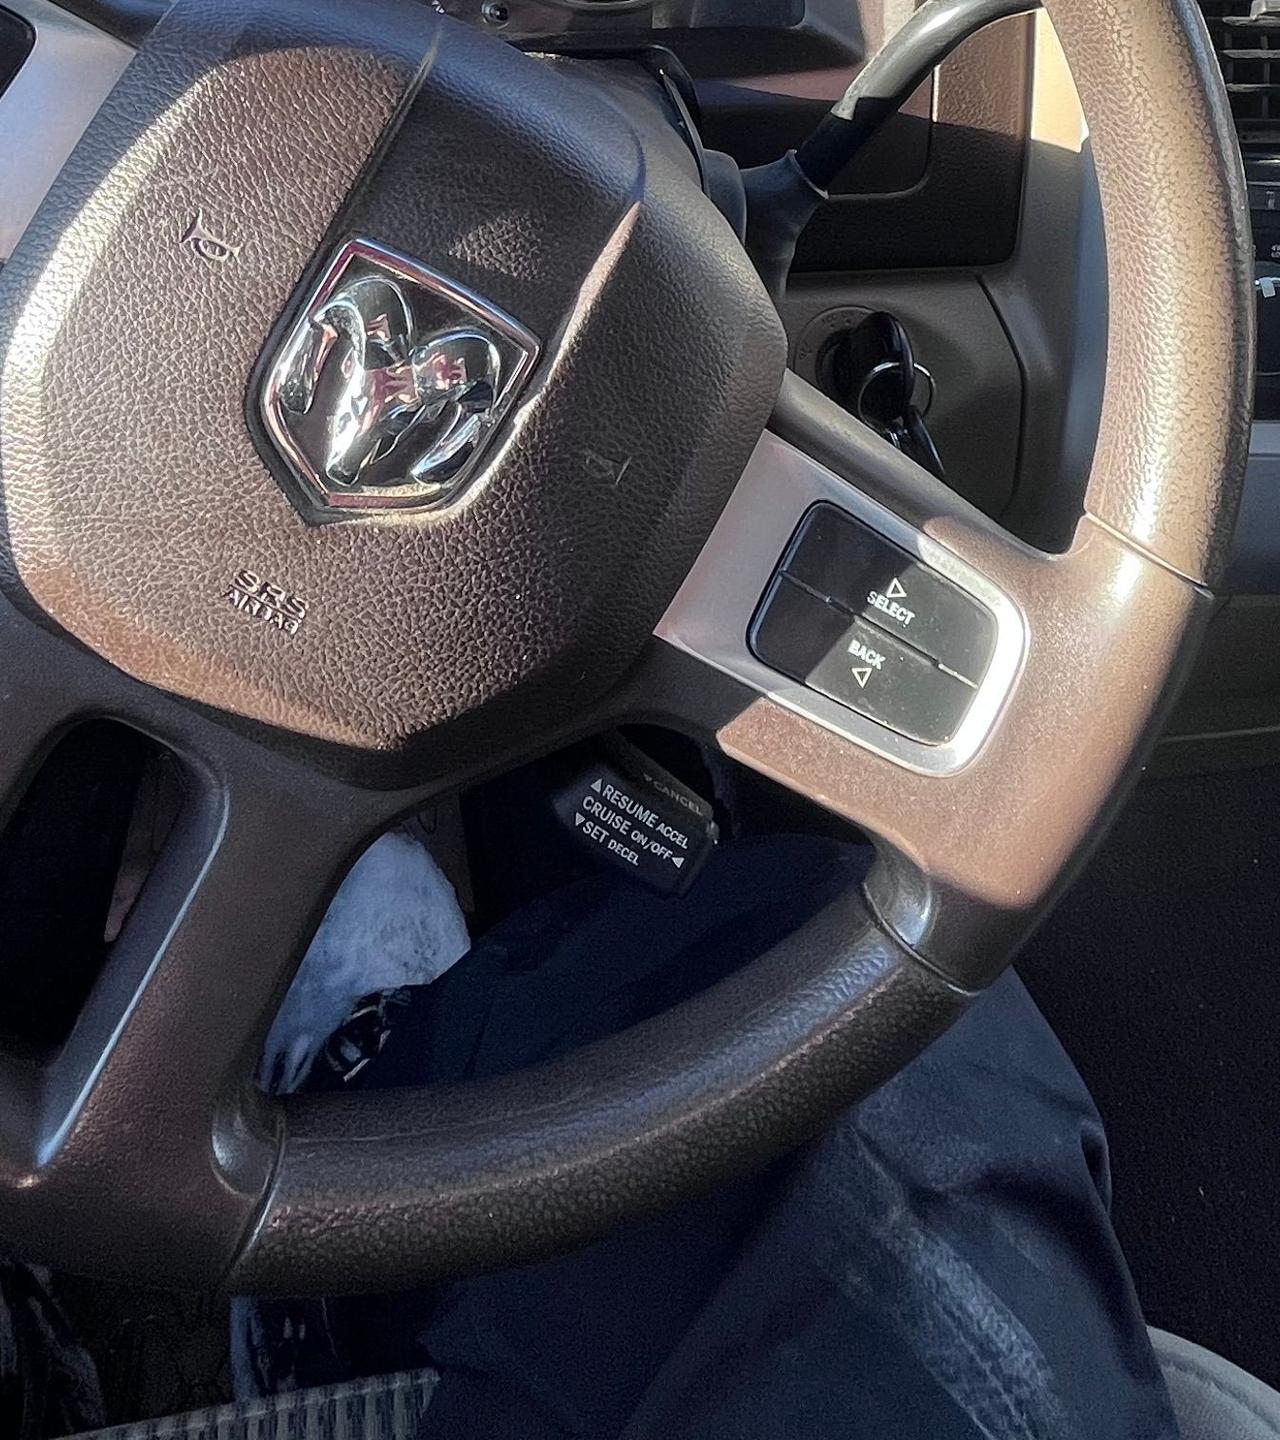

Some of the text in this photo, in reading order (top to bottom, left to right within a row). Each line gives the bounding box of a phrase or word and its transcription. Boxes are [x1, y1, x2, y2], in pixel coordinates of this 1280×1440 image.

[234, 570, 309, 619] SRS
[867, 591, 915, 625] SELECT
[848, 639, 886, 670] BACK
[602, 784, 688, 849] RESUME ACCEL
[653, 780, 703, 817] CANCEL
[582, 821, 639, 866] SET DECEL
[583, 796, 673, 860] CRUISE ON/OFF
